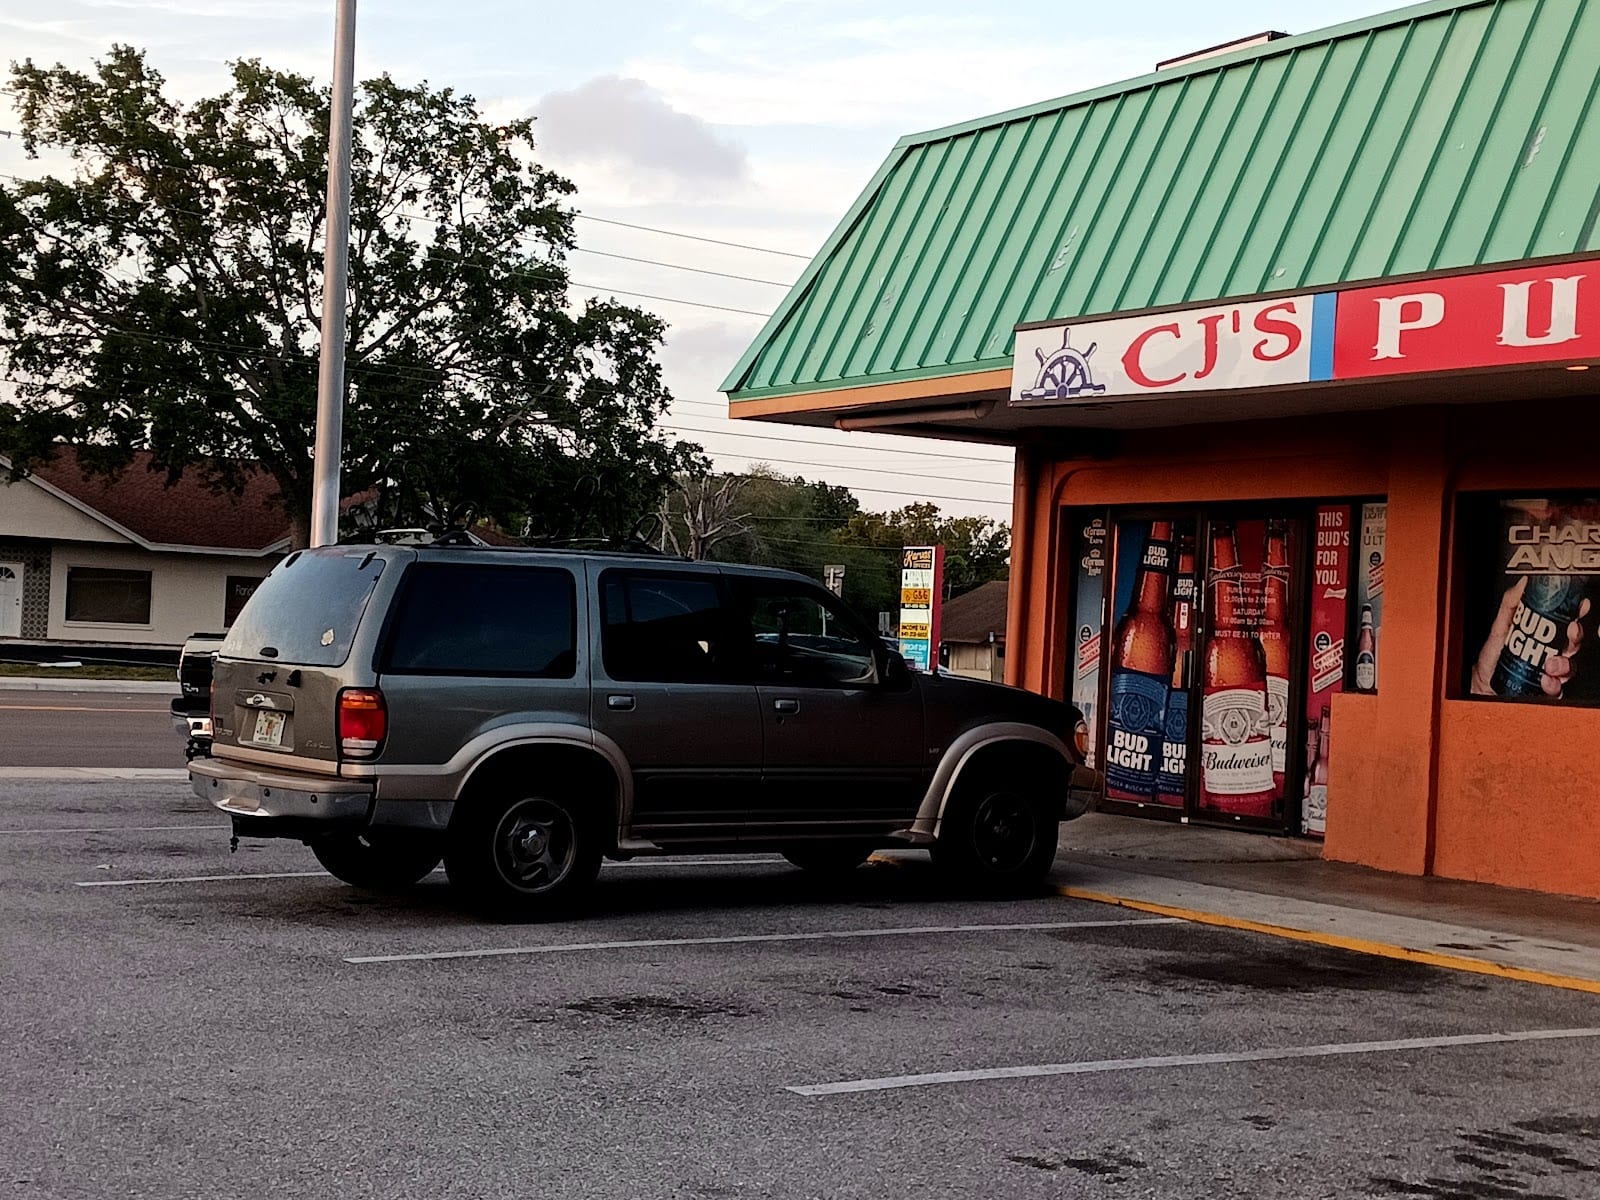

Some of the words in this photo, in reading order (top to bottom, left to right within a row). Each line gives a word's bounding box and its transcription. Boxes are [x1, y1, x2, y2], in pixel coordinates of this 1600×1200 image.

[1121, 301, 1303, 388] CJ'S
[1318, 511, 1343, 528] THIS
[1083, 526, 1106, 539] Corona
[1317, 530, 1350, 547] BUD'S
[1508, 525, 1600, 545] CHAR
[1147, 545, 1167, 557] BUD
[1316, 550, 1338, 566] FOR
[1506, 544, 1600, 569] ANG
[1081, 556, 1105, 569] Corona
[1143, 554, 1170, 568] LIGHT
[1177, 578, 1194, 588] BUD
[1315, 569, 1341, 585] YOU.
[1232, 607, 1265, 616] SATURDAY
[1512, 600, 1557, 645] BUD
[1214, 629, 1232, 638] MUST
[1232, 630, 1241, 638] BE
[1242, 630, 1249, 639] 21
[1250, 631, 1259, 639] TO
[1260, 630, 1281, 640] ENTER
[1113, 729, 1149, 754] BUD
[1106, 744, 1153, 772] LIGHT
[1205, 751, 1270, 771] Budweiser
